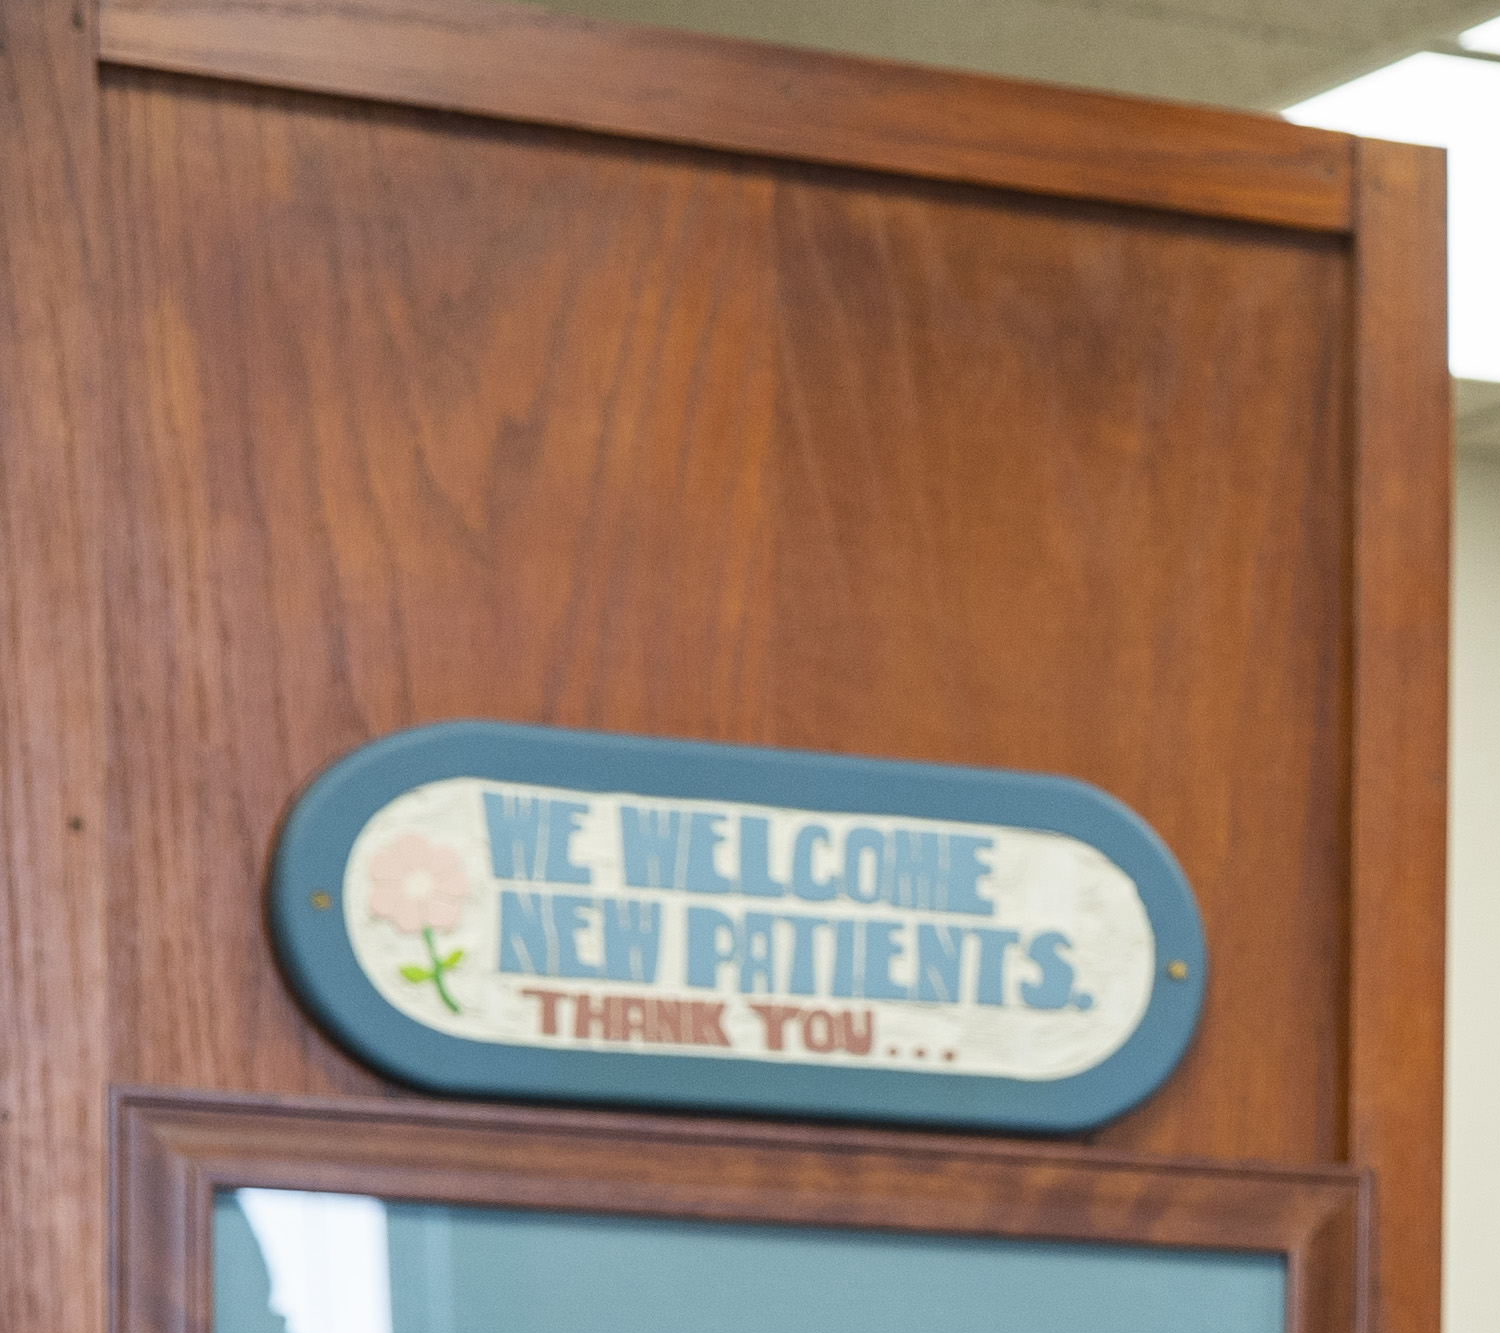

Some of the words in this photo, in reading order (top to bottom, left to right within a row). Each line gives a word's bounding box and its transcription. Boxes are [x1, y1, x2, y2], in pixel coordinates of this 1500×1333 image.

[482, 791, 592, 886] WE
[619, 805, 996, 917] WELCOME
[498, 889, 664, 985] NEW
[519, 987, 732, 1048] THANK
